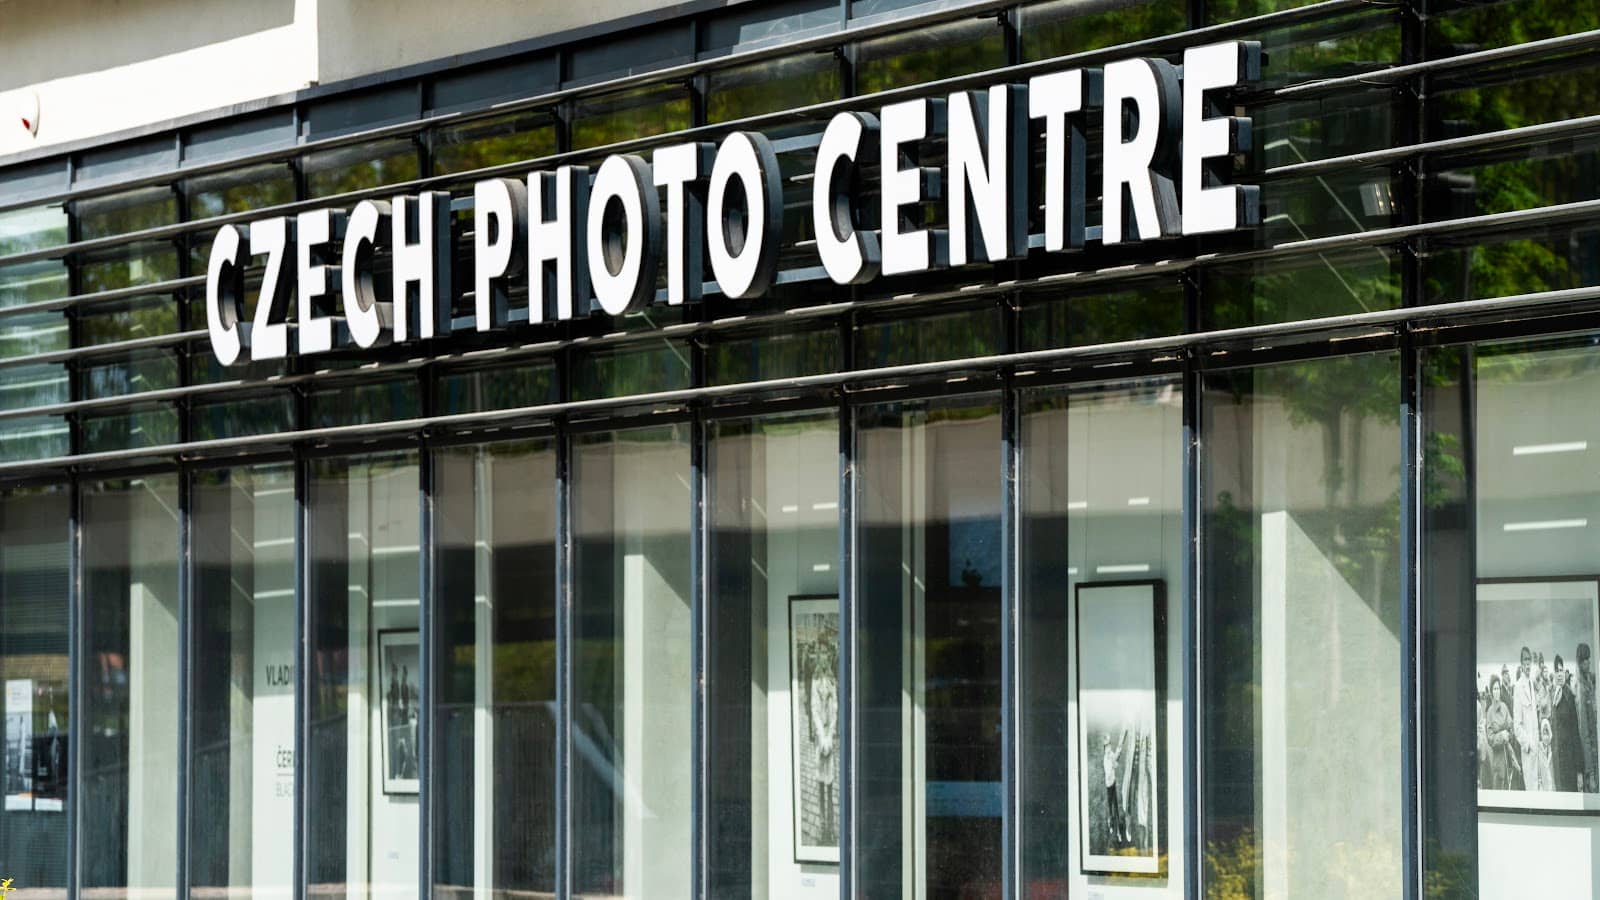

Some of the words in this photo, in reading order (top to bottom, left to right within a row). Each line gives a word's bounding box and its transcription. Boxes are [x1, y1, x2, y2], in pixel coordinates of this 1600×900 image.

[206, 191, 448, 367] CZECH
[474, 131, 778, 332] PHOTO
[813, 40, 1258, 286] CENTRE
